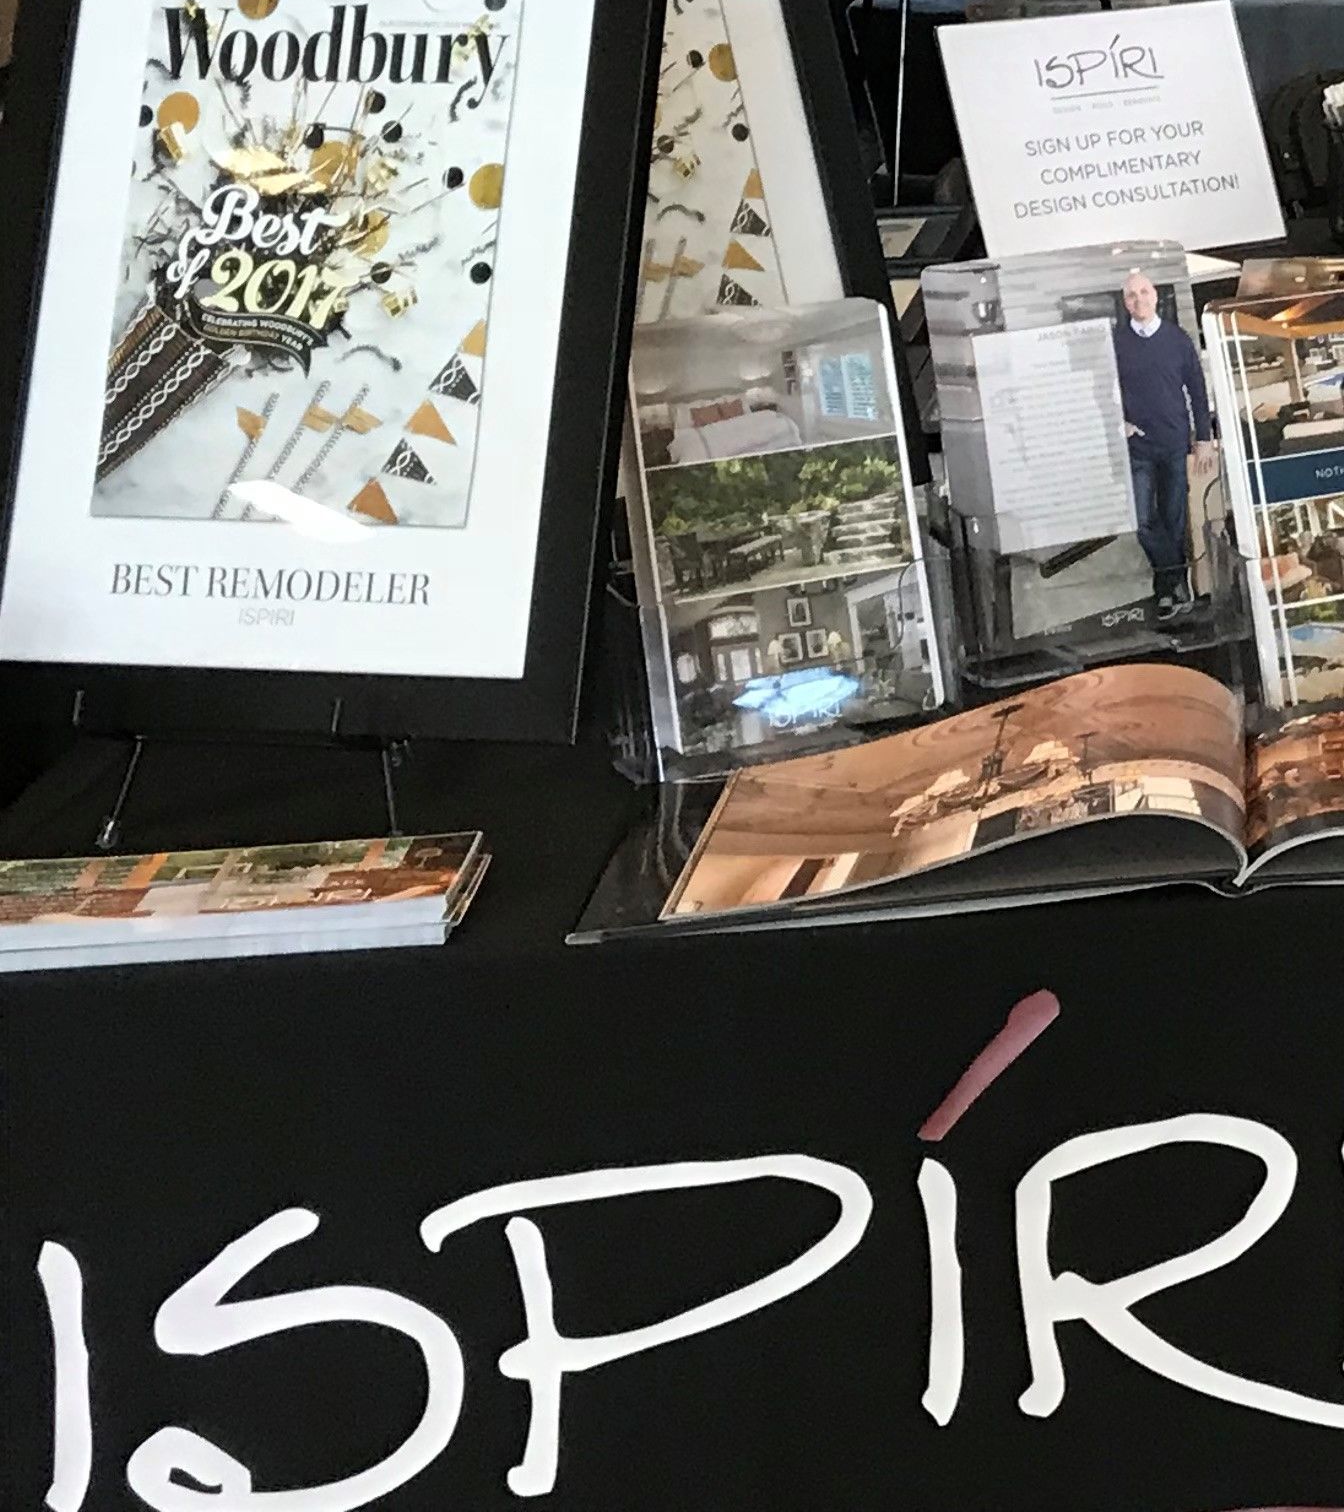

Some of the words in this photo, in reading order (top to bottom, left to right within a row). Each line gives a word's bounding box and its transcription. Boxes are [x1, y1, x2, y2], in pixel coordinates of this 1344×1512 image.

[161, 3, 511, 110] Woodbury
[1024, 136, 1071, 157] SIGN
[1076, 132, 1102, 150] UP
[1107, 127, 1146, 147] FOR
[1149, 119, 1204, 140] YOUR
[1040, 149, 1202, 186] COMPLIMENTARY
[196, 183, 351, 256] Best
[1013, 194, 1087, 220] DESIGN
[1092, 172, 1240, 209] CONSULTATION!
[166, 228, 211, 300] of
[200, 246, 347, 331] 2017
[109, 562, 199, 598] BEST
[205, 566, 432, 606] REMODELER
